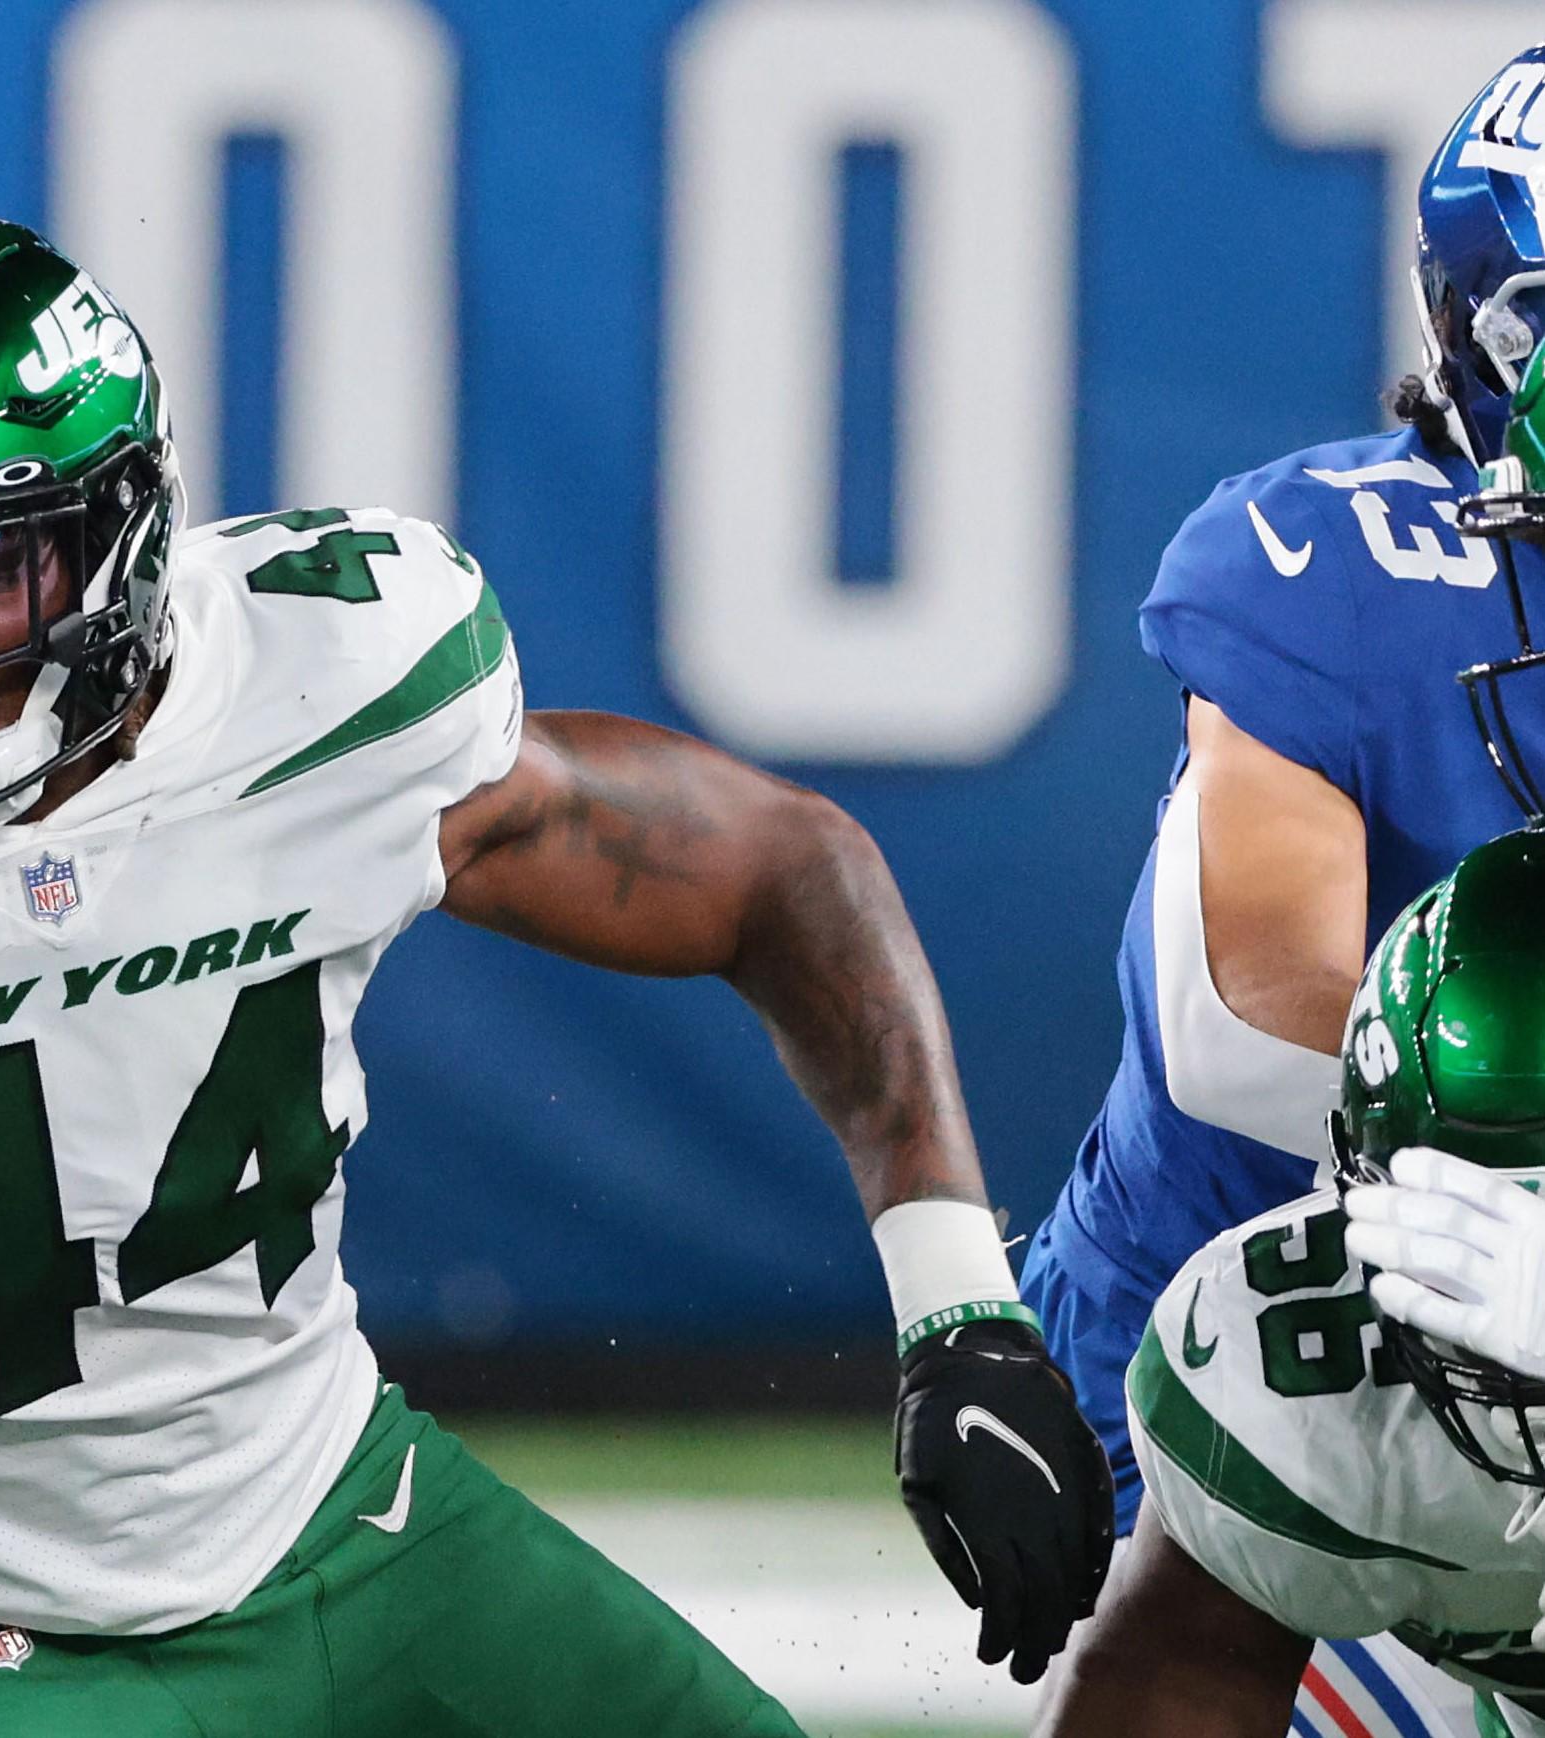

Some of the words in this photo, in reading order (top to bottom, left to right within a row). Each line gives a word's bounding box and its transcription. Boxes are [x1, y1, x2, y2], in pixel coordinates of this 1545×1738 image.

[1303, 454, 1499, 589] 13
[34, 883, 76, 912] NFL
[61, 908, 312, 1010] YORK
[970, 1302, 1001, 1317] ALL
